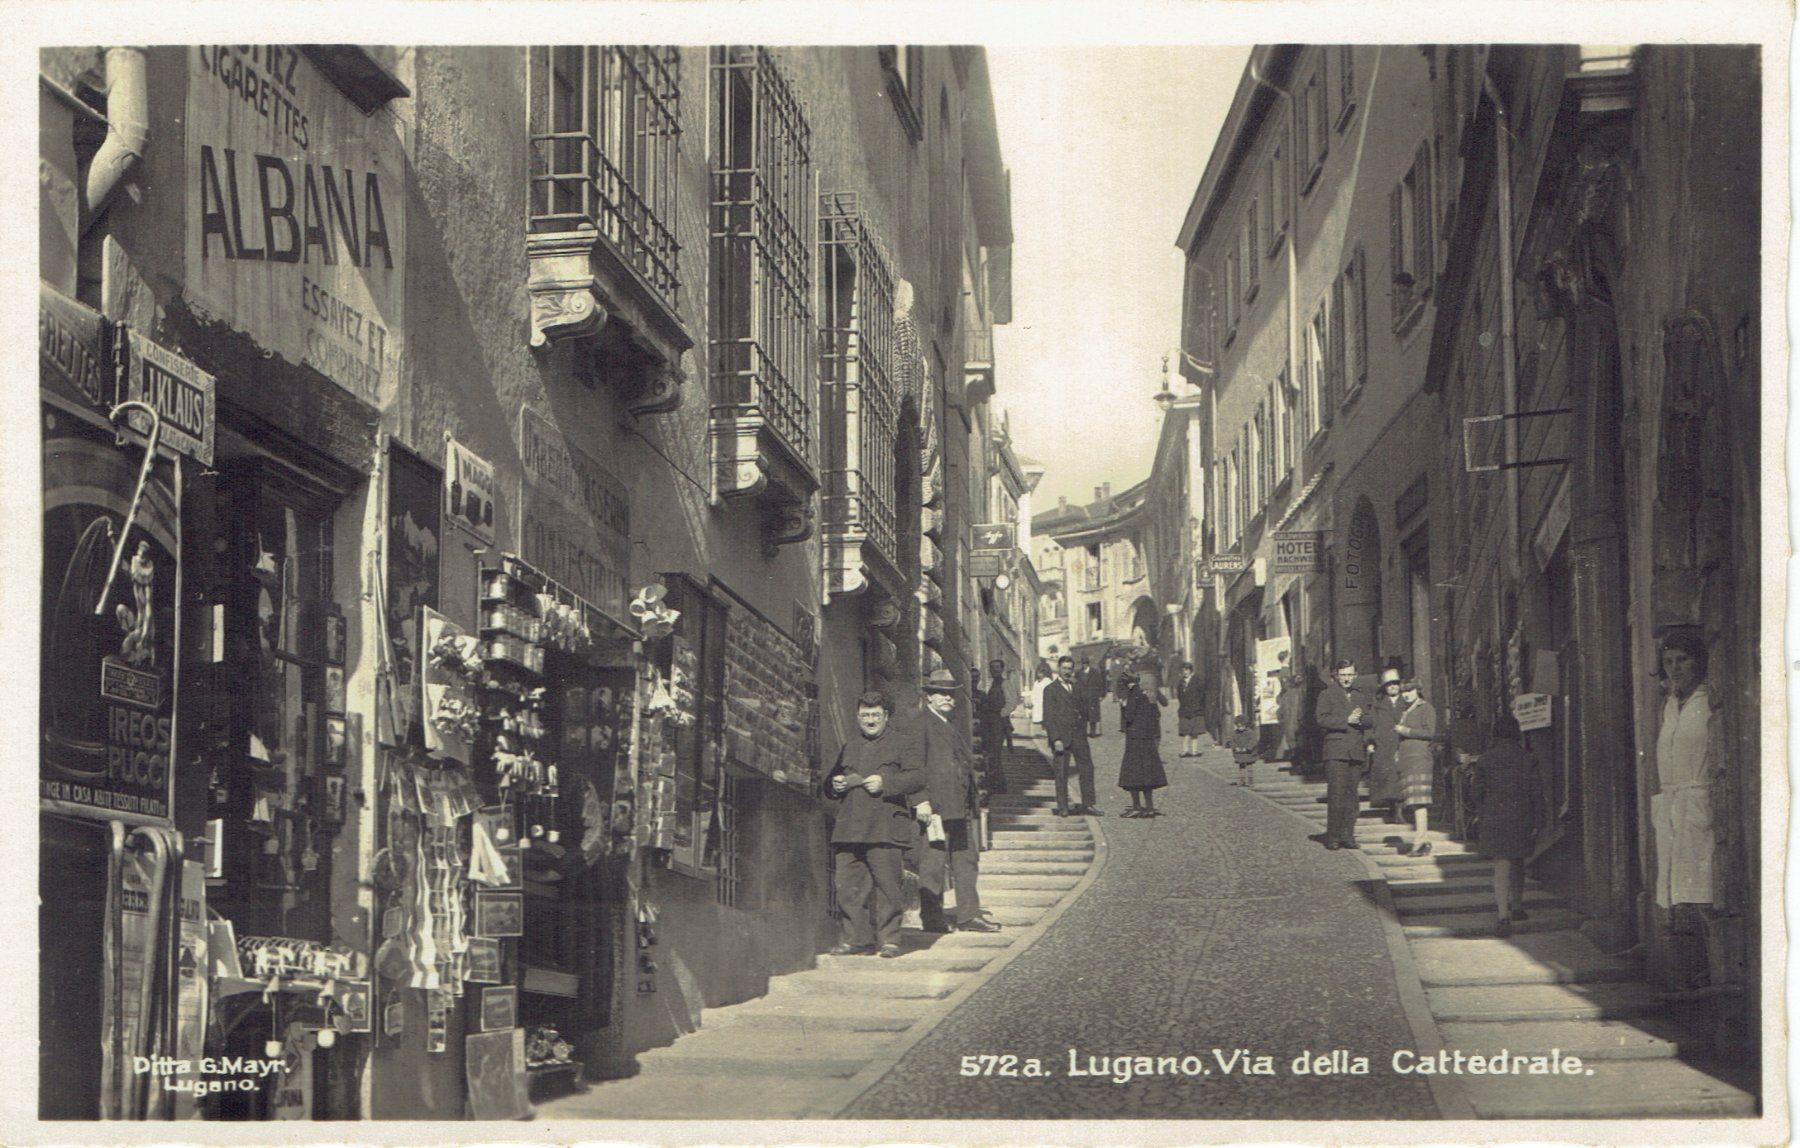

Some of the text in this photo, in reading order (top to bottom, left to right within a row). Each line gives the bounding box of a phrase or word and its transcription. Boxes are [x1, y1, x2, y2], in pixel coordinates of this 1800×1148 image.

[200, 44, 309, 151] CIGARETTES
[202, 145, 394, 269] ALBANA
[303, 276, 387, 361] ESSAYEZ ET
[1277, 541, 1318, 554] HOTEL
[109, 706, 170, 750] IREOS
[108, 746, 168, 792] PUCCI
[73, 785, 92, 803] CASA
